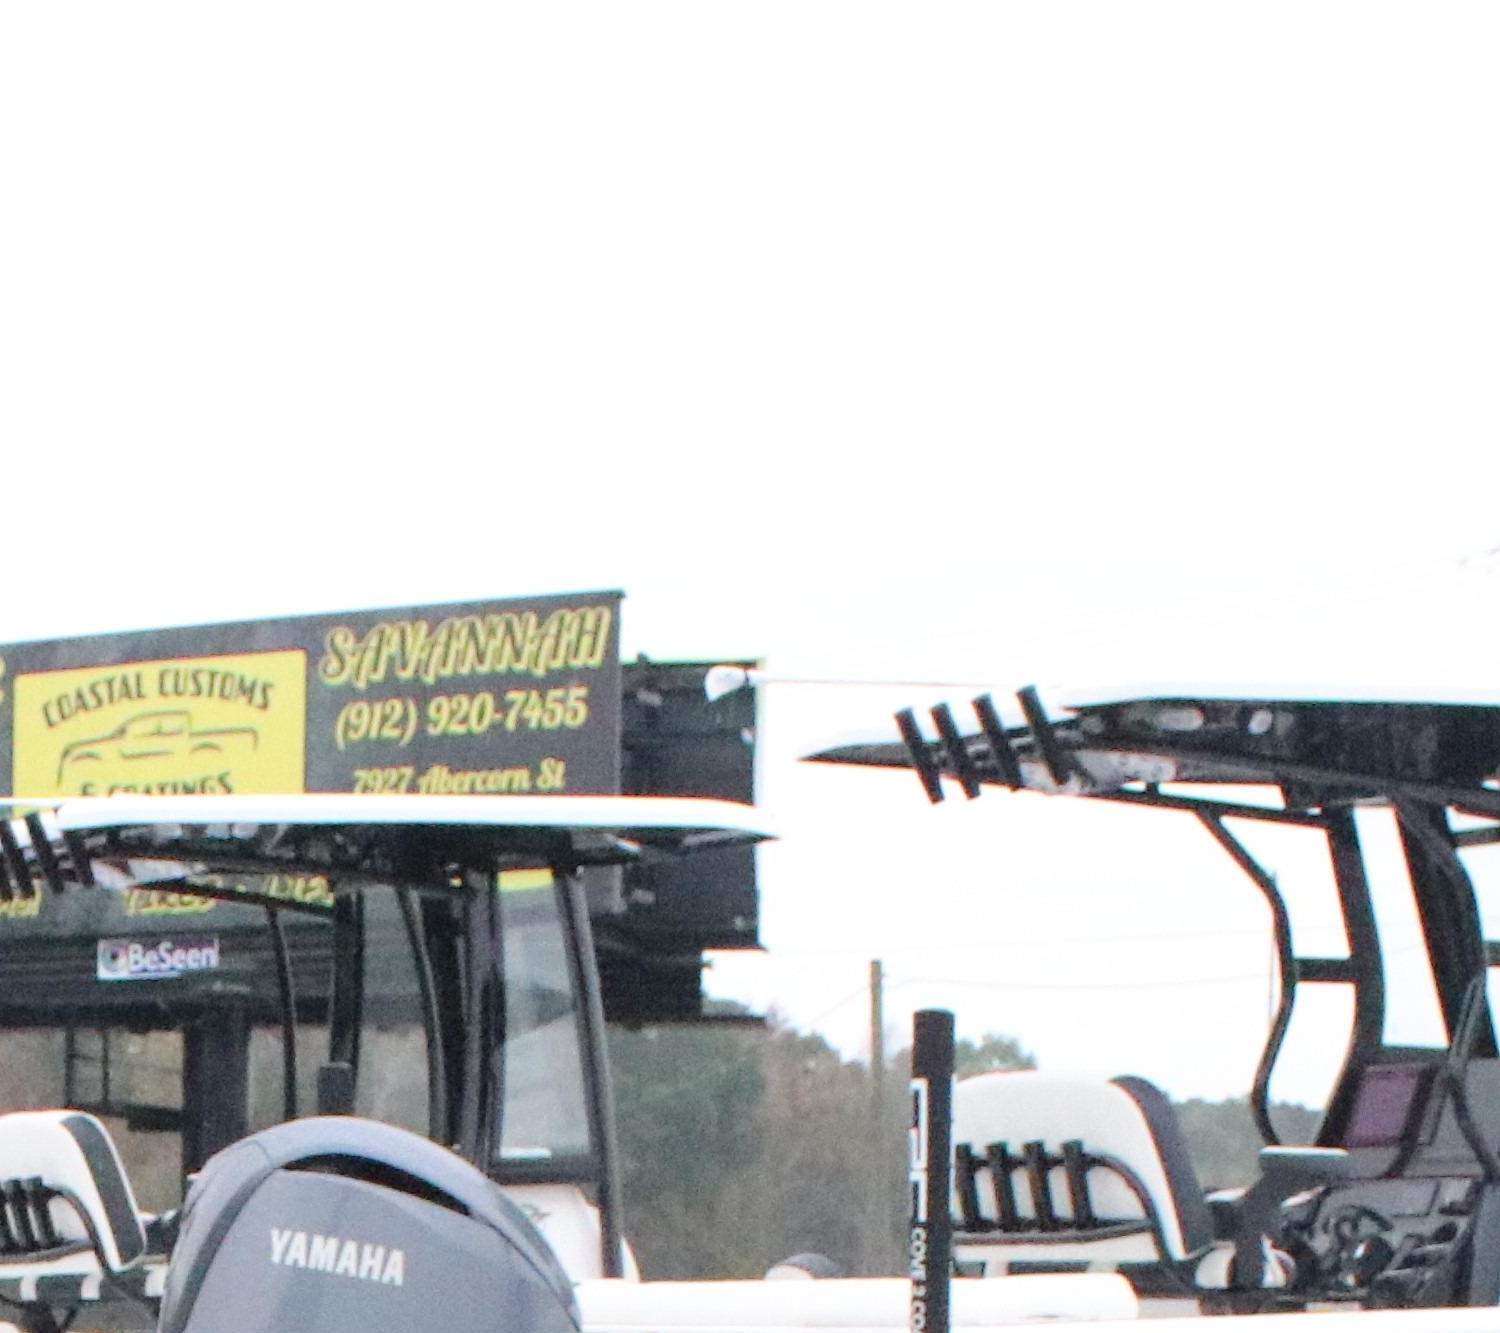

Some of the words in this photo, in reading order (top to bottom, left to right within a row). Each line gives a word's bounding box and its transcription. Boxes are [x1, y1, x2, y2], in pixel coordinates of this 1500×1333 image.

[318, 605, 612, 690] SAVANNAH
[41, 671, 147, 728] COASTAL
[158, 667, 276, 711] CUSTOMS
[335, 697, 418, 750] (912)
[427, 684, 589, 735] 920-7455
[535, 757, 567, 790] St
[270, 1228, 404, 1287] YAMAHA
